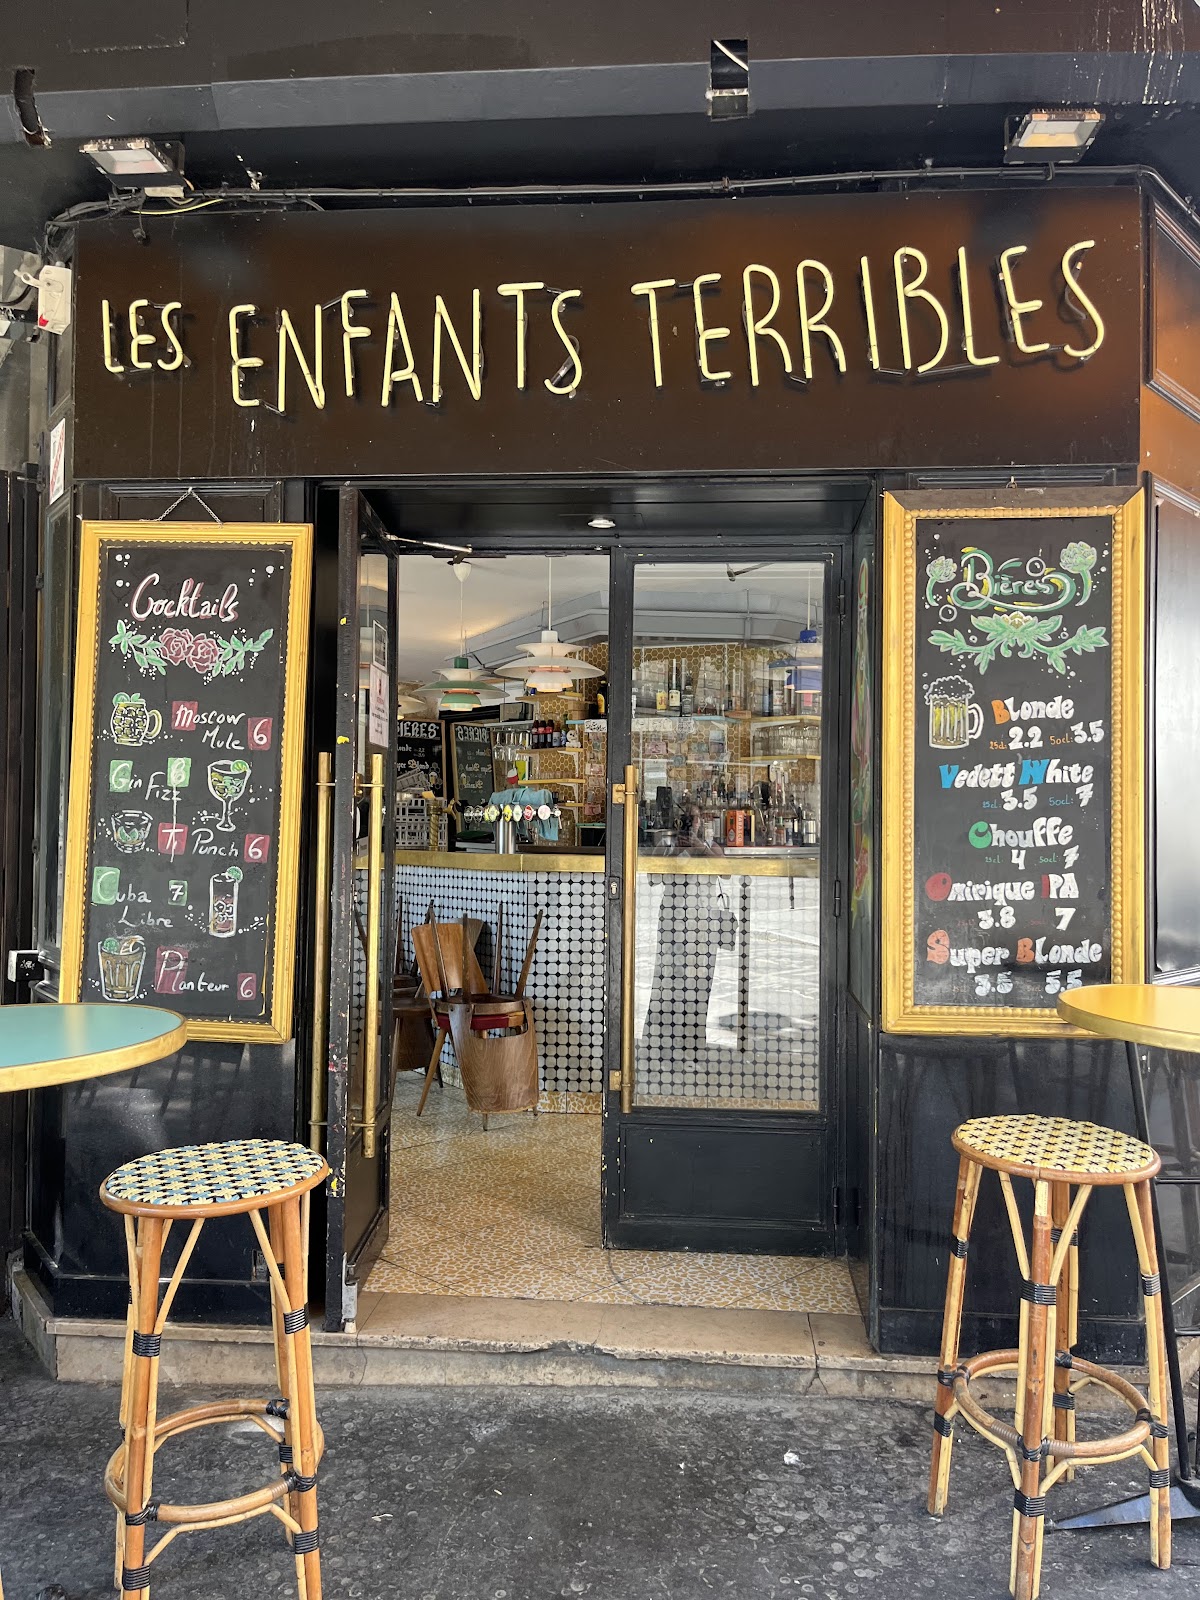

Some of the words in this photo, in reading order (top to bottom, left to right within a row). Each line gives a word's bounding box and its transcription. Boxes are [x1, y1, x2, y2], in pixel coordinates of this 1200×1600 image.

[101, 299, 183, 373] LES
[229, 282, 582, 413] ENFANTS
[631, 240, 1105, 387] TERRIBLES
[951, 549, 1068, 612] Bières
[131, 573, 239, 622] Cocktails
[174, 704, 246, 728] Moscow
[397, 721, 439, 739] IERES
[202, 725, 245, 750] Mule
[252, 718, 268, 745] 6
[1008, 726, 1043, 750] 2.2
[1070, 720, 1105, 743] 3.5
[111, 763, 143, 789] Gin
[145, 771, 182, 801] Fizz
[939, 762, 1016, 788] Vedett
[1018, 759, 1094, 785] White
[1000, 786, 1038, 811] 3.5
[1075, 783, 1094, 807] 7
[191, 828, 239, 857] Punch
[248, 836, 265, 860] 6
[968, 817, 1074, 849] Chouffe
[1011, 849, 1026, 870] 4
[1063, 845, 1079, 869] 7
[98, 871, 151, 903] Cuba
[169, 884, 184, 901] 7
[925, 872, 1035, 906] Onirique
[1041, 872, 1079, 899] IPA
[118, 905, 173, 929] Libre
[977, 906, 1016, 929] 3.8
[1055, 907, 1076, 931] 7
[926, 929, 1010, 974] Super
[156, 949, 229, 992] Planteur
[240, 976, 254, 998] 6
[975, 971, 1013, 997] 3.5
